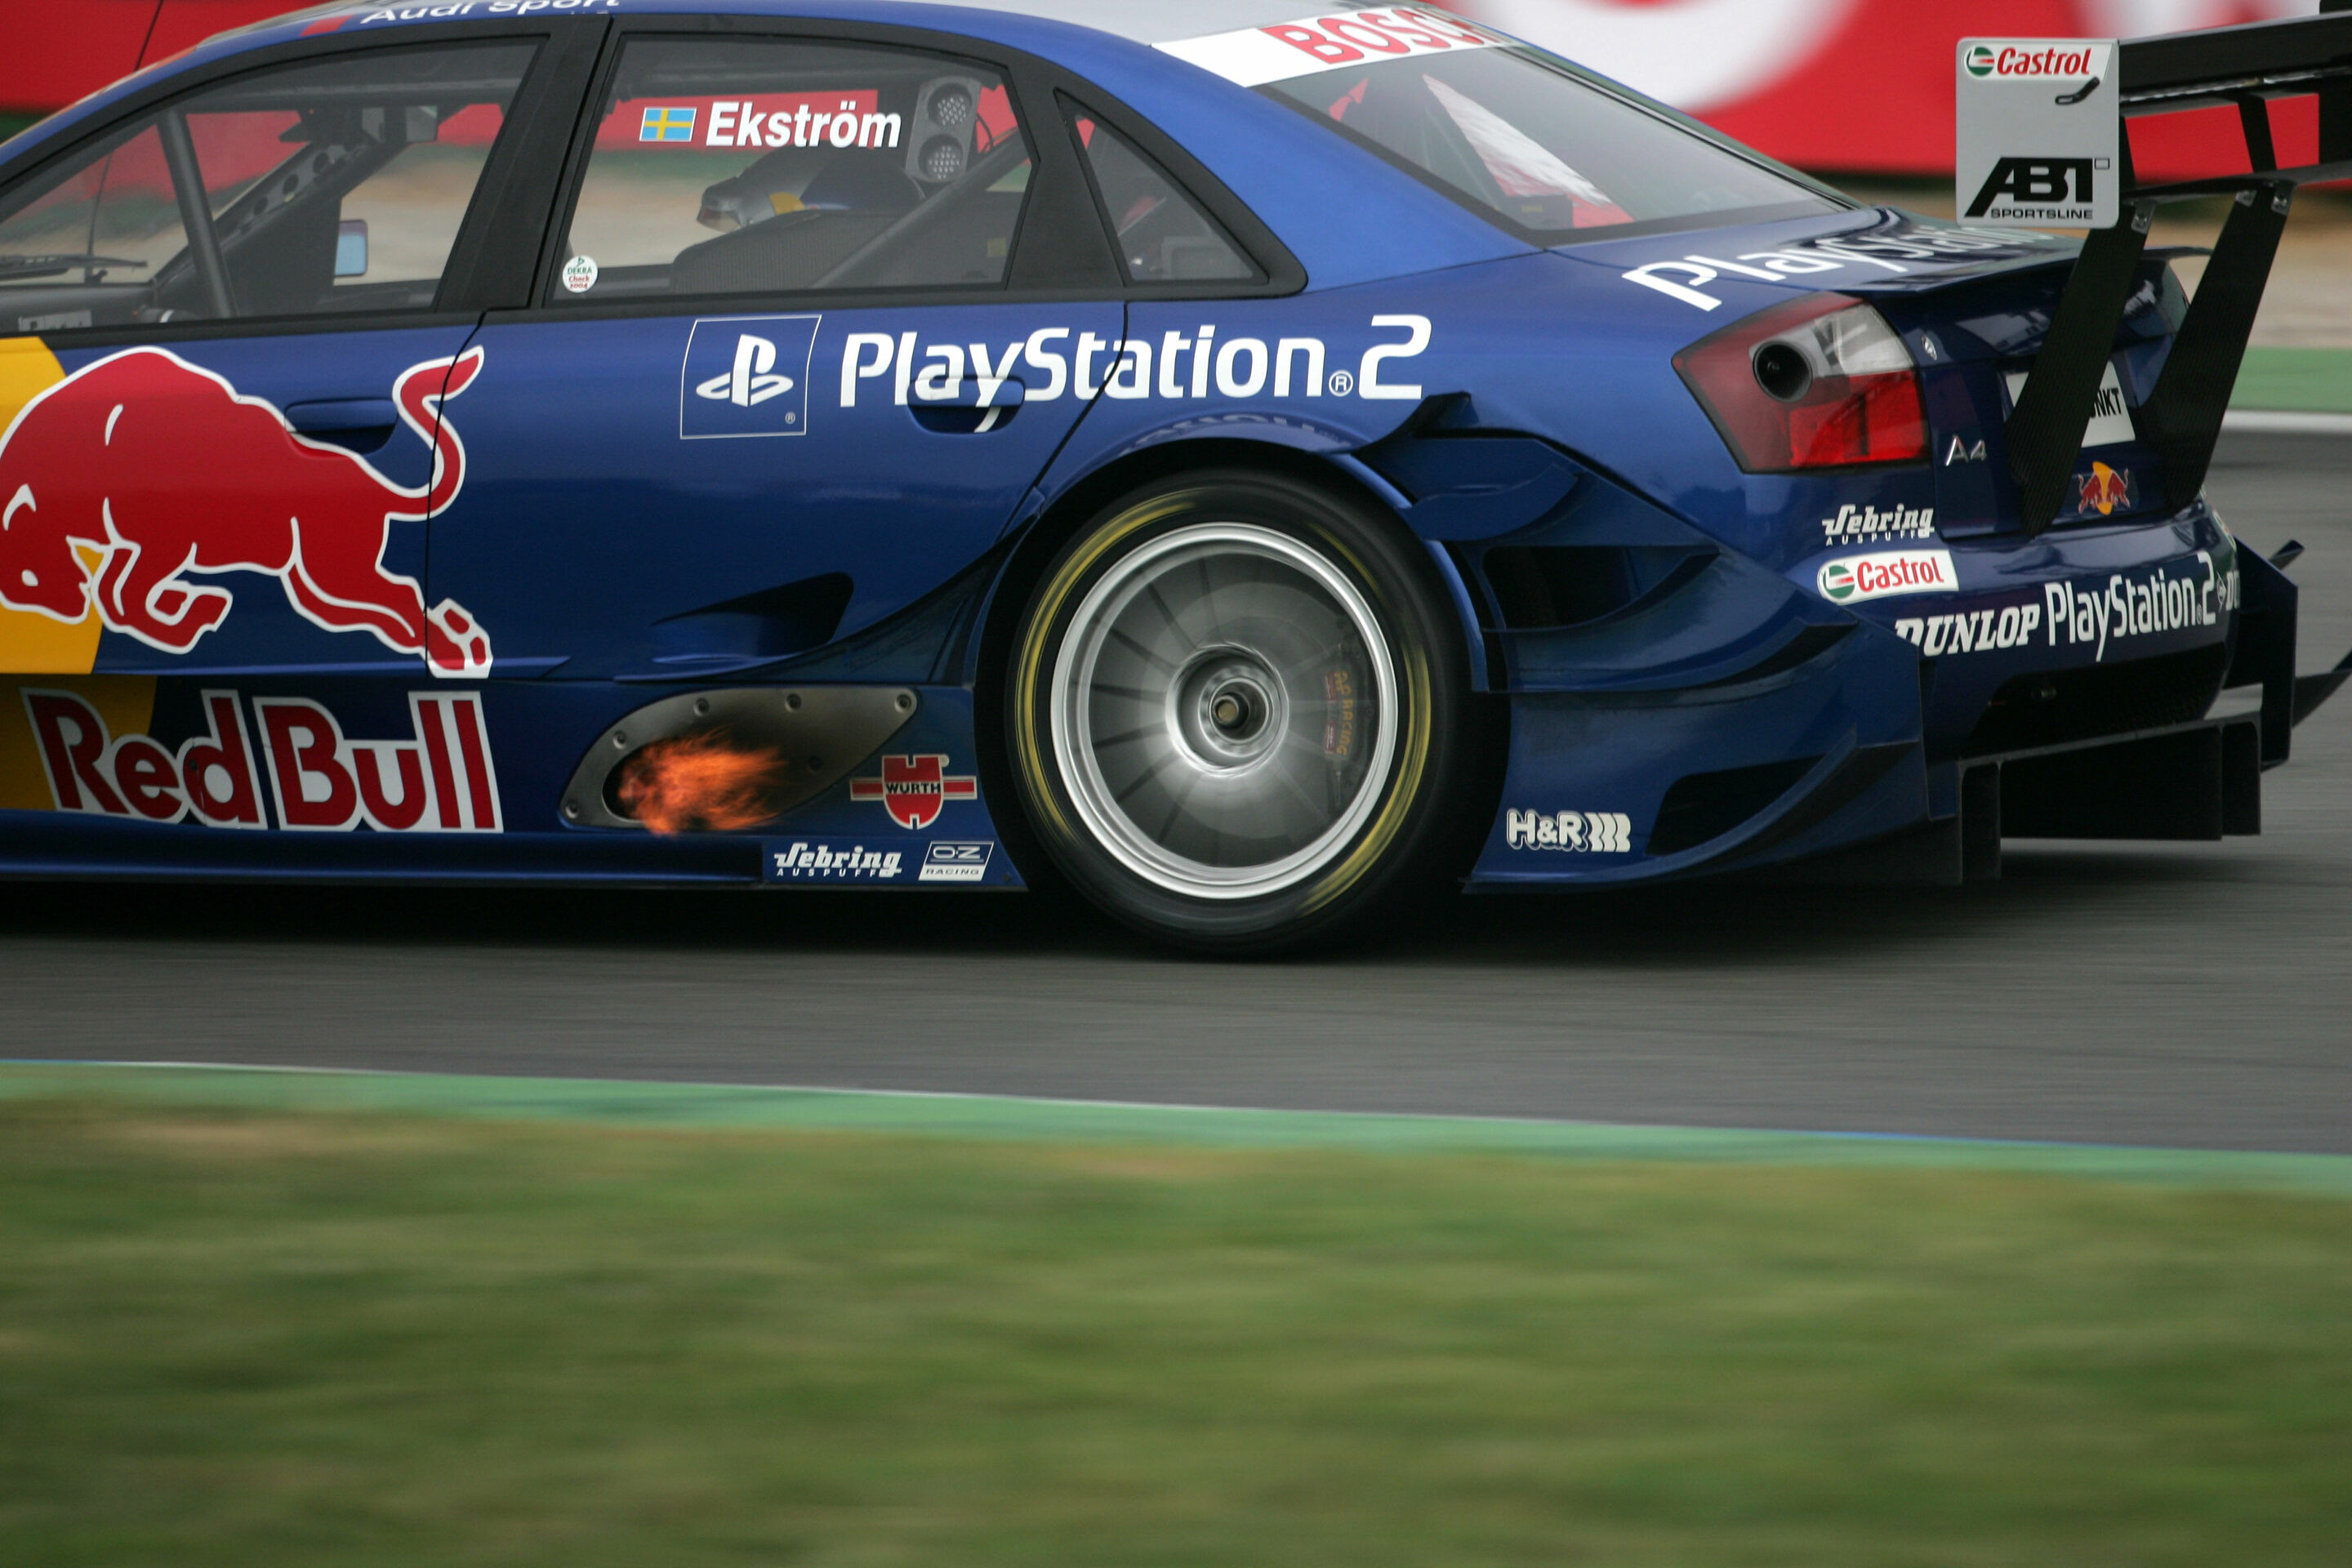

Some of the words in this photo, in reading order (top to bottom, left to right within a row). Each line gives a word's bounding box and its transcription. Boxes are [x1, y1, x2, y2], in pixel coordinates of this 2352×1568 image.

[360, 2, 475, 24] Audi
[1998, 47, 2091, 75] Castrol
[706, 100, 902, 149] Ekström
[1964, 157, 2093, 218] ABT
[1991, 208, 2093, 219] SPORTSLINE
[1944, 434, 1987, 466] A4
[1822, 503, 1935, 538] Sebring
[1857, 556, 1944, 592] Castrol
[1895, 603, 2040, 657] DUNLOP
[20, 687, 268, 831] Red
[252, 691, 504, 833] Bull
[1507, 808, 1588, 852] H&R
[774, 842, 902, 878] Sebring
[776, 868, 877, 878] AUSPUFF
